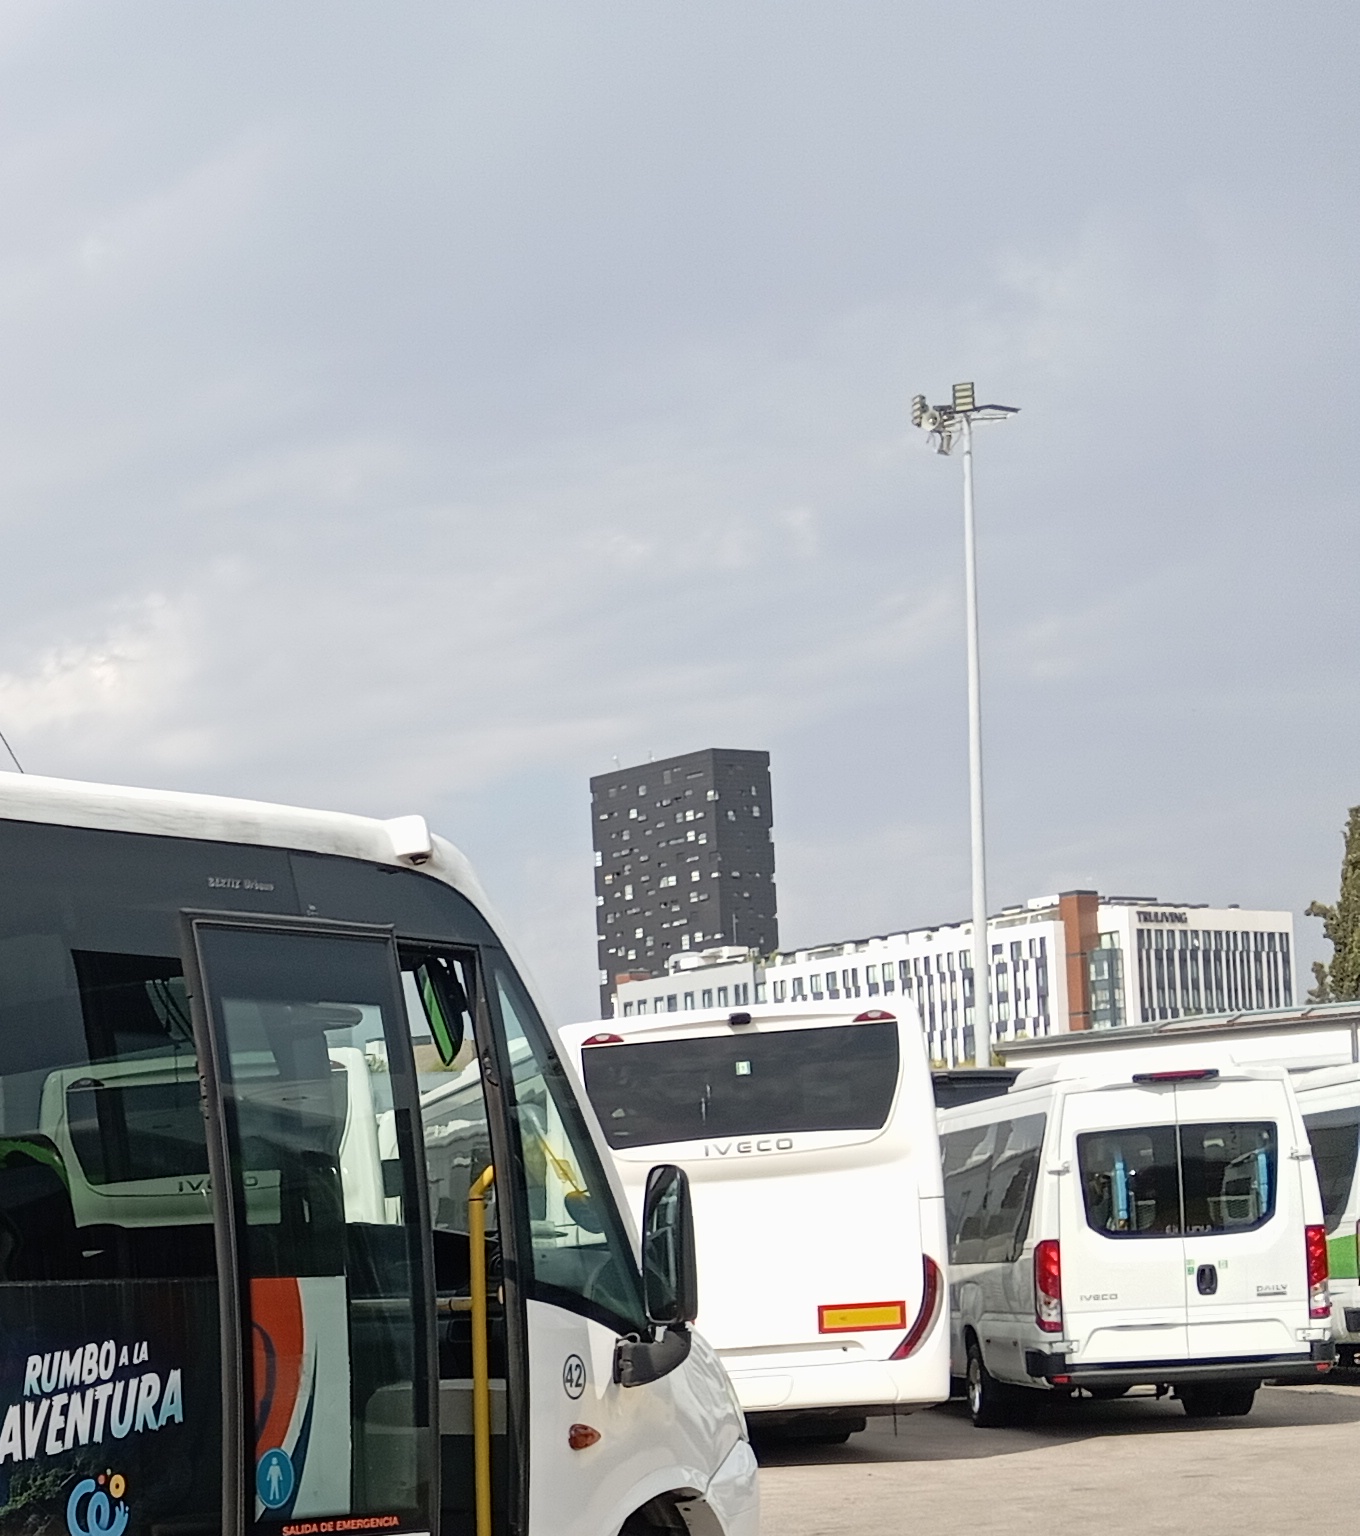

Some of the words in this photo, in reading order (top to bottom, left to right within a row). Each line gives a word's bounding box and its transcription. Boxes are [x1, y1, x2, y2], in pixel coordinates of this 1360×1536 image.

[704, 1138, 793, 1157] IVECO
[1080, 1293, 1118, 1301] IVECO
[1256, 1284, 1288, 1292] DAILY
[23, 1339, 116, 1397] RUMBO
[118, 1345, 129, 1367] A
[132, 1341, 148, 1365] LA
[565, 1363, 582, 1388] 42
[282, 1523, 319, 1536] SALIDA
[320, 1521, 334, 1532] DE
[336, 1516, 400, 1531] EMERGENCIA
